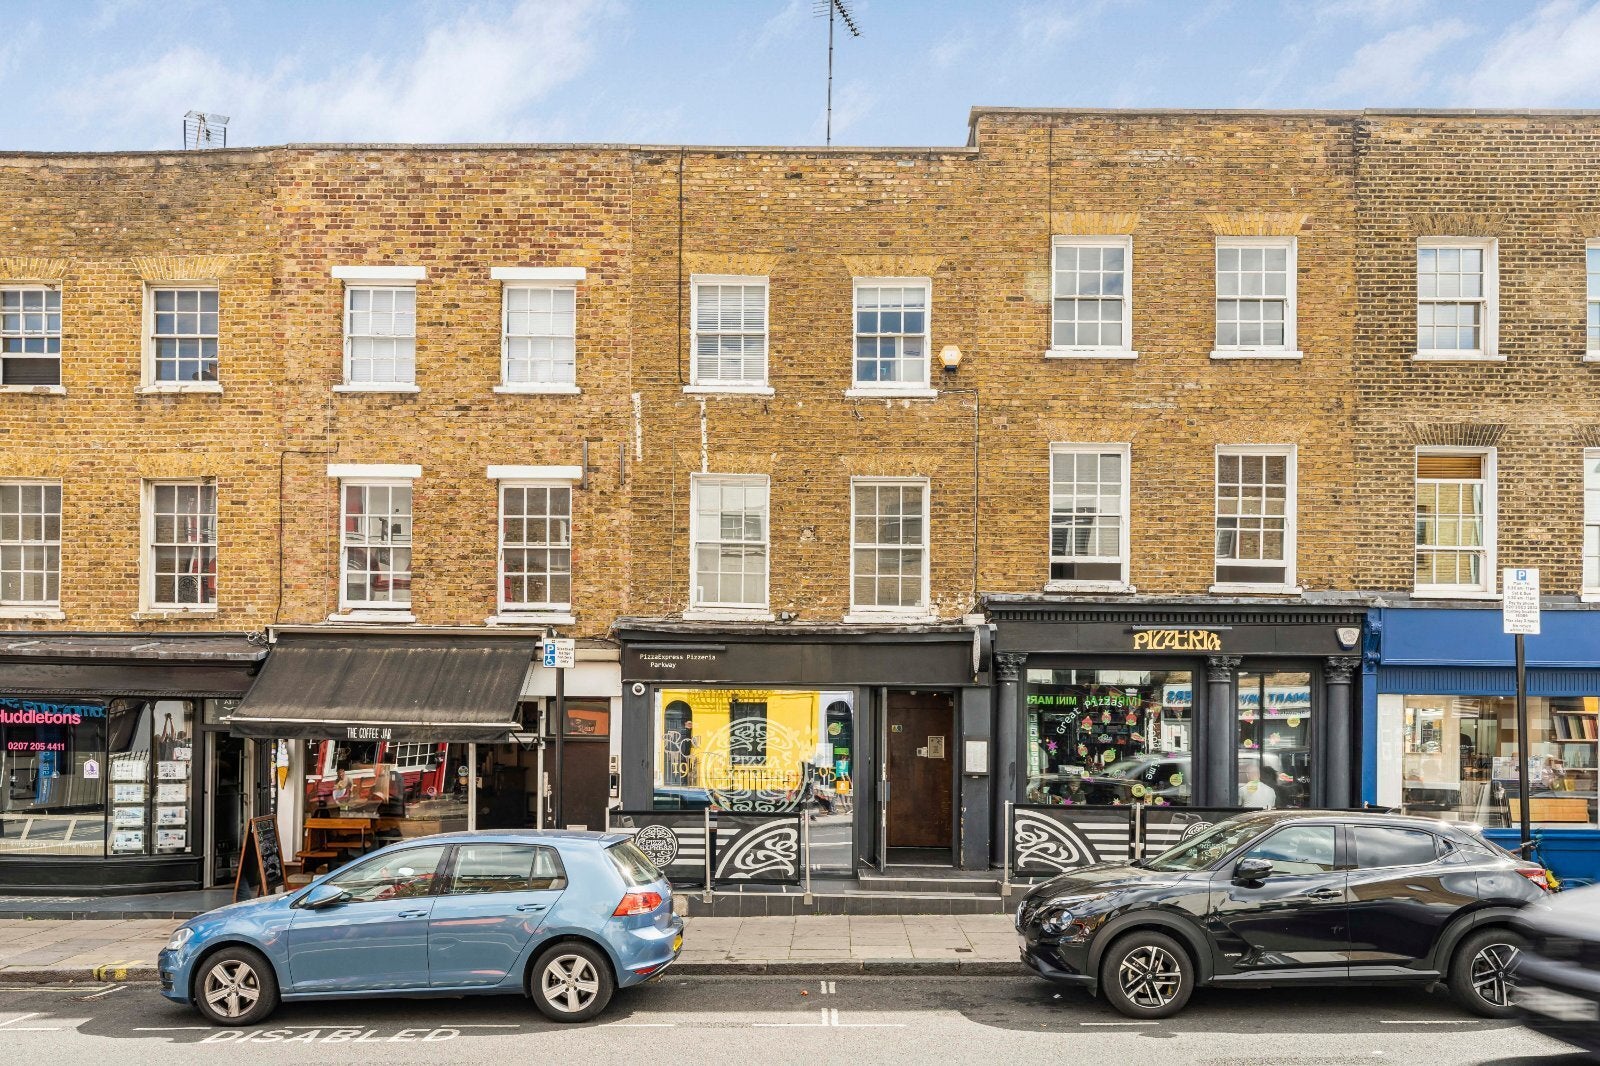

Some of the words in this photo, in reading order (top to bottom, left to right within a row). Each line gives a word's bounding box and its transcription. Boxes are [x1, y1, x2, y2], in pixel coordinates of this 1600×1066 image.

[1132, 630, 1221, 650] PIZZERIA
[1056, 707, 1081, 734] Great
[347, 728, 358, 738] THE
[359, 728, 380, 738] COFFEE
[380, 728, 392, 740] JAR
[8, 742, 28, 750] 0207
[201, 1029, 460, 1044] DISABLED
